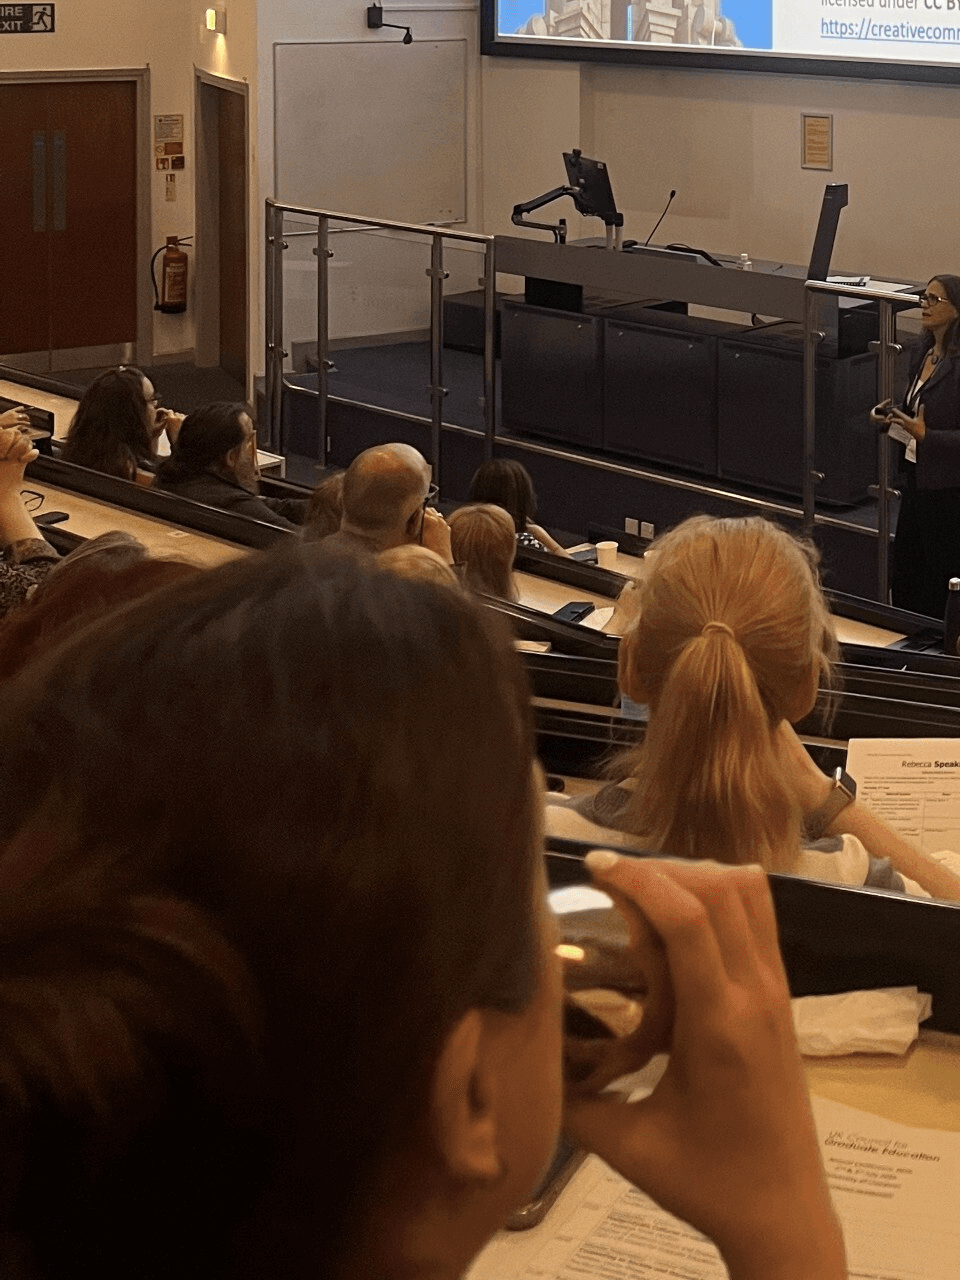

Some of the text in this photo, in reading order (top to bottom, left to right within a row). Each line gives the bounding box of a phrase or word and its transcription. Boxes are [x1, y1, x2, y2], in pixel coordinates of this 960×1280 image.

[0, 6, 23, 17] IRE
[0, 20, 23, 31] XIT
[902, 760, 932, 768] Rebecca
